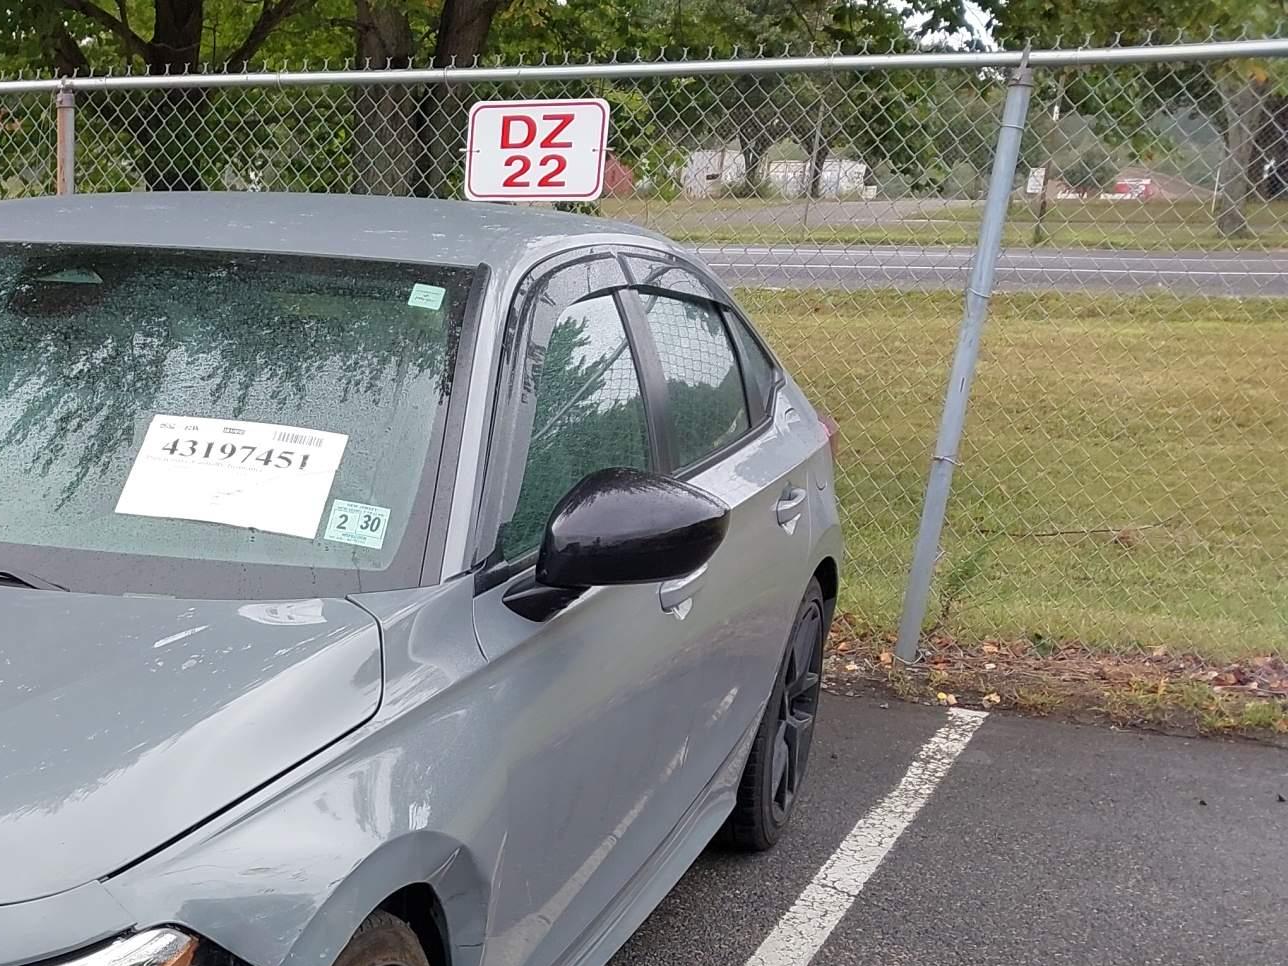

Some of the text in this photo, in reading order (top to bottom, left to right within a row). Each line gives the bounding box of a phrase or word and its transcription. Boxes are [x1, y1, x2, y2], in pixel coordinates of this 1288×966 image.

[500, 113, 575, 150] DZ
[502, 154, 567, 188] 22
[161, 438, 310, 470] 43197451
[336, 513, 381, 533] 2 30
